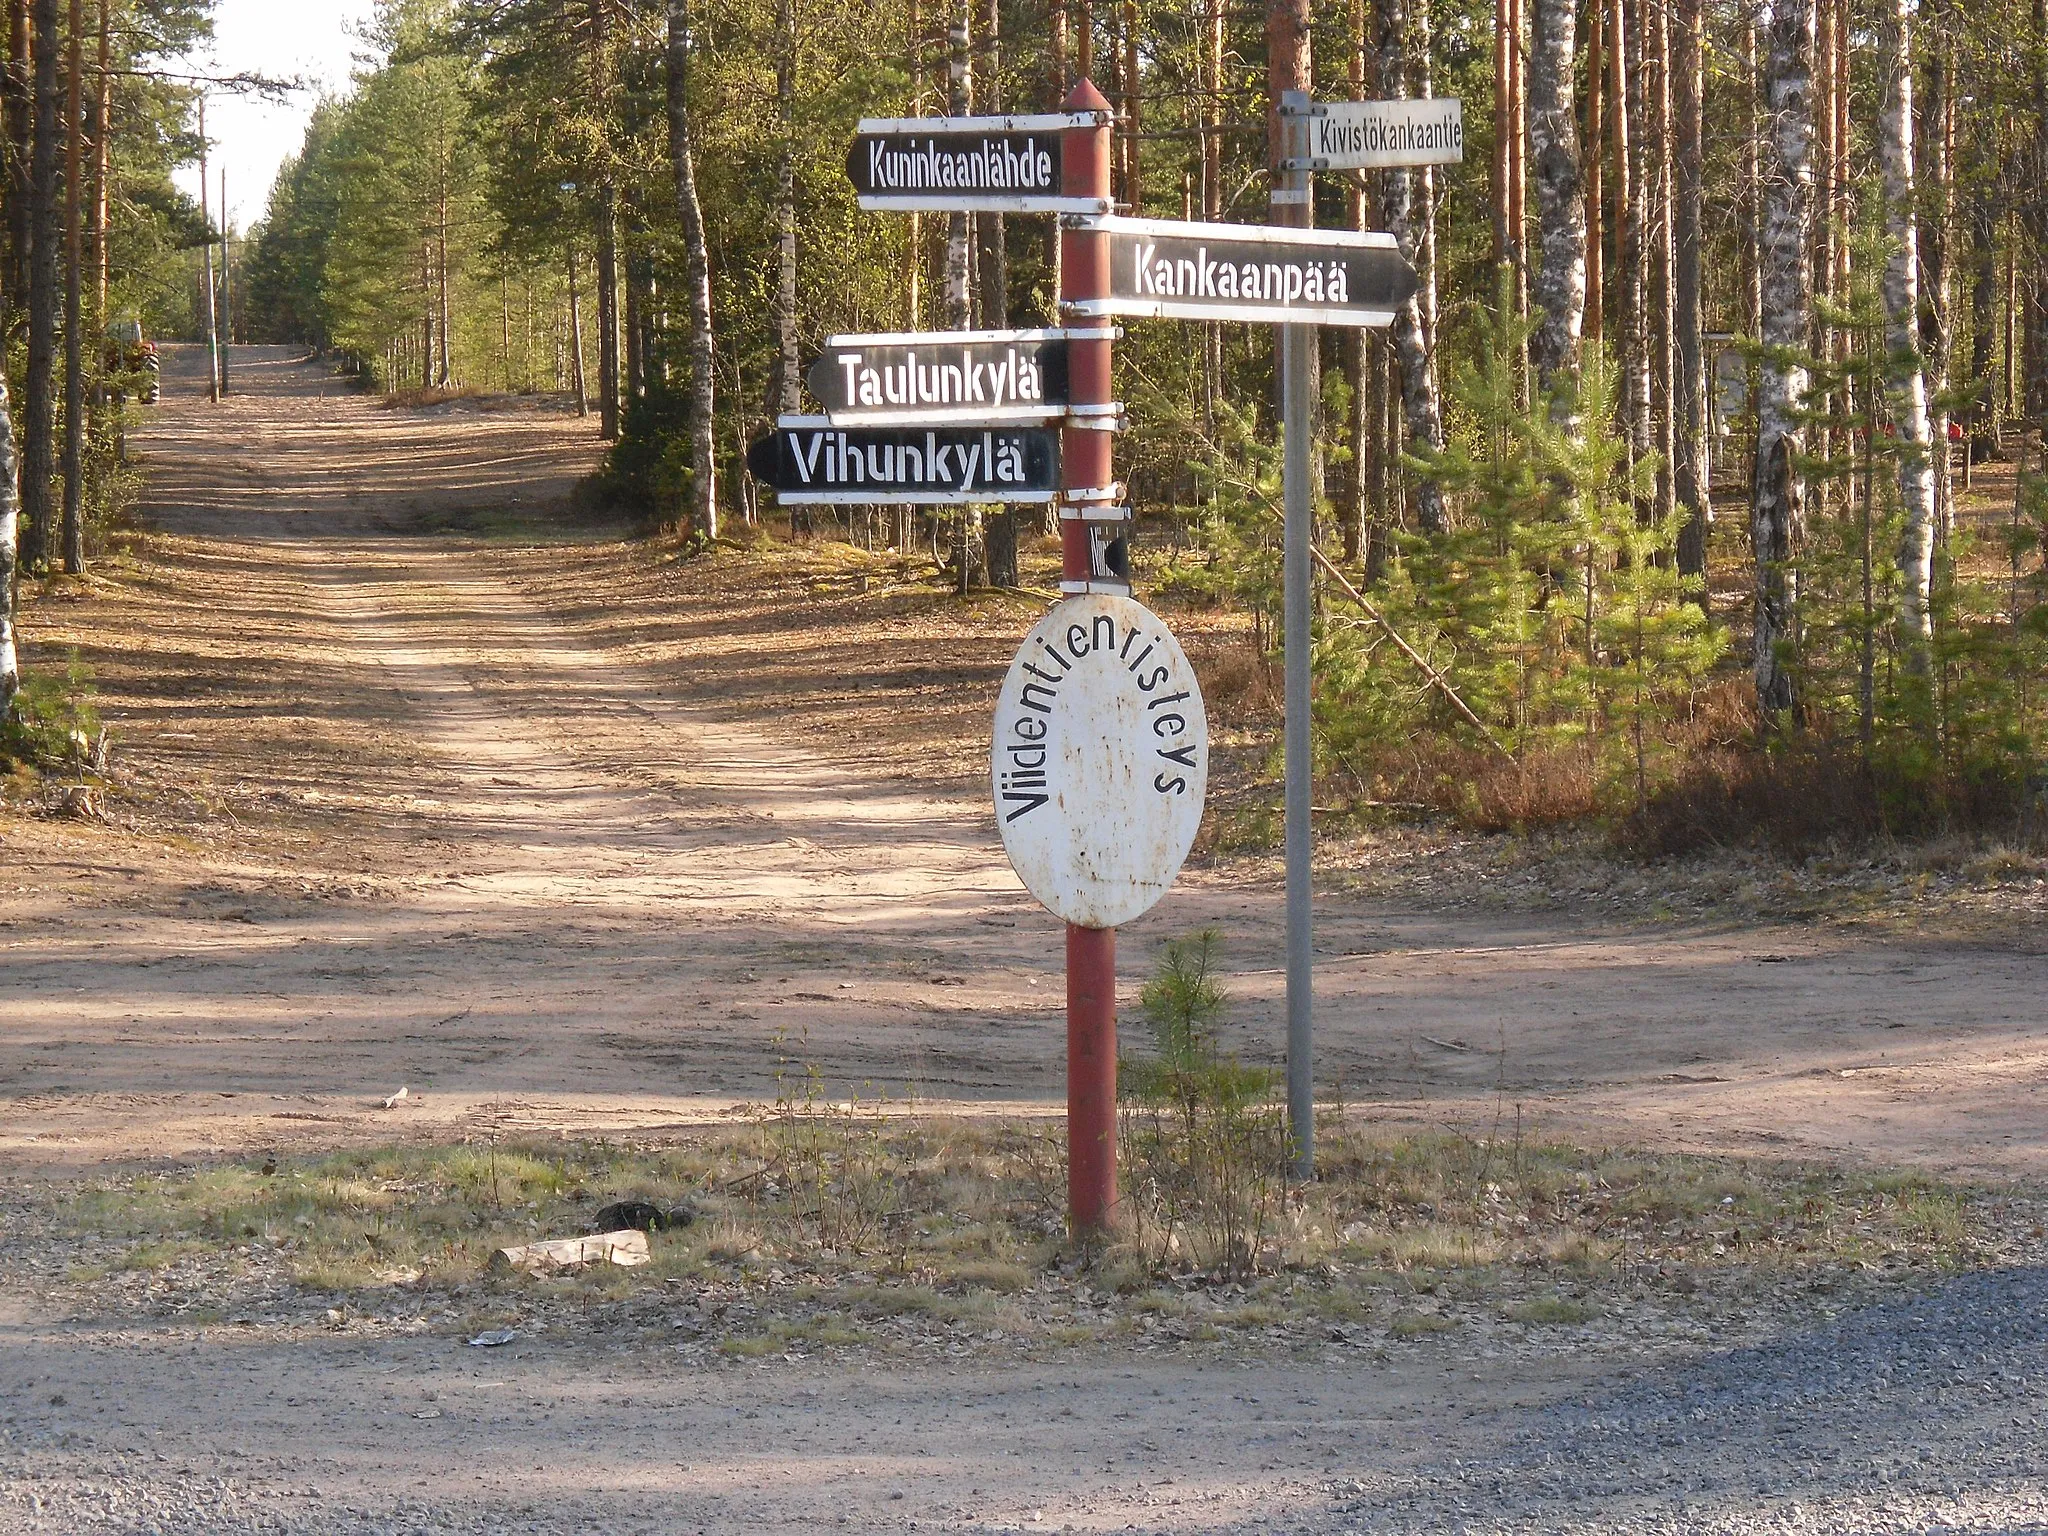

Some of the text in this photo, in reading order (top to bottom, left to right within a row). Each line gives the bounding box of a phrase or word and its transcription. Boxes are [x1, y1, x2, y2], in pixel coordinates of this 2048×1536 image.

[1320, 112, 1462, 153] Kivistökankaantie
[869, 139, 1052, 187] Kuninkaanlähde
[1134, 244, 1349, 304] Kankaanpää
[837, 350, 1041, 406] Taulunkylä
[788, 432, 1026, 491] Vihunkylä
[1001, 614, 1197, 823] Viidentienristeys
